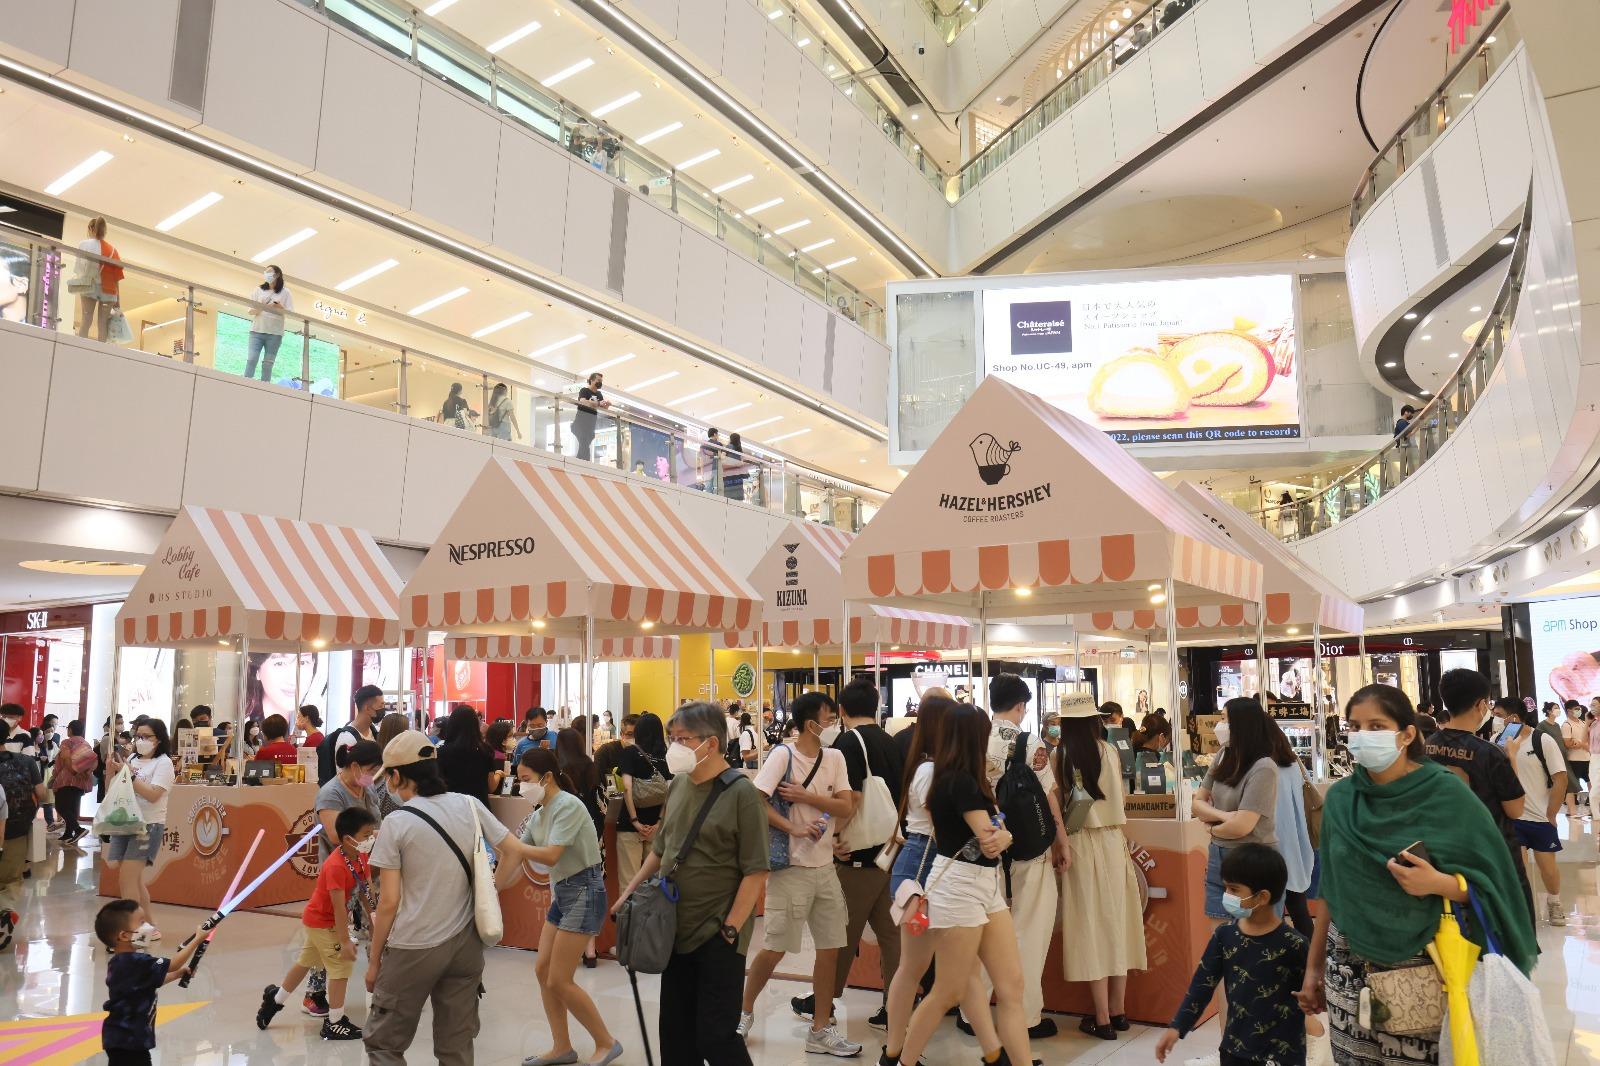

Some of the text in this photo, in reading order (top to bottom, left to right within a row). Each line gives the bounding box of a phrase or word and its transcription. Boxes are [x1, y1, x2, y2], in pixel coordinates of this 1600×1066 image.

[992, 364, 1018, 372] Shop
[1071, 362, 1092, 370] apm
[1109, 433, 1131, 442] 022,
[1132, 432, 1160, 442] please
[1186, 430, 1203, 439] this
[1205, 430, 1222, 440] QR
[1224, 429, 1246, 438] code
[1248, 429, 1257, 437] to
[1260, 427, 1291, 436] record
[962, 511, 1025, 523] COFFEE ROASTERS
[161, 545, 196, 567] Lobby
[448, 536, 535, 566] NESPRESSO
[179, 562, 201, 582] Cafe
[776, 588, 808, 607] KIZUNA
[1569, 618, 1598, 631] Shop
[914, 664, 969, 676] CHANEL
[1425, 744, 1475, 761] TOMIYASU
